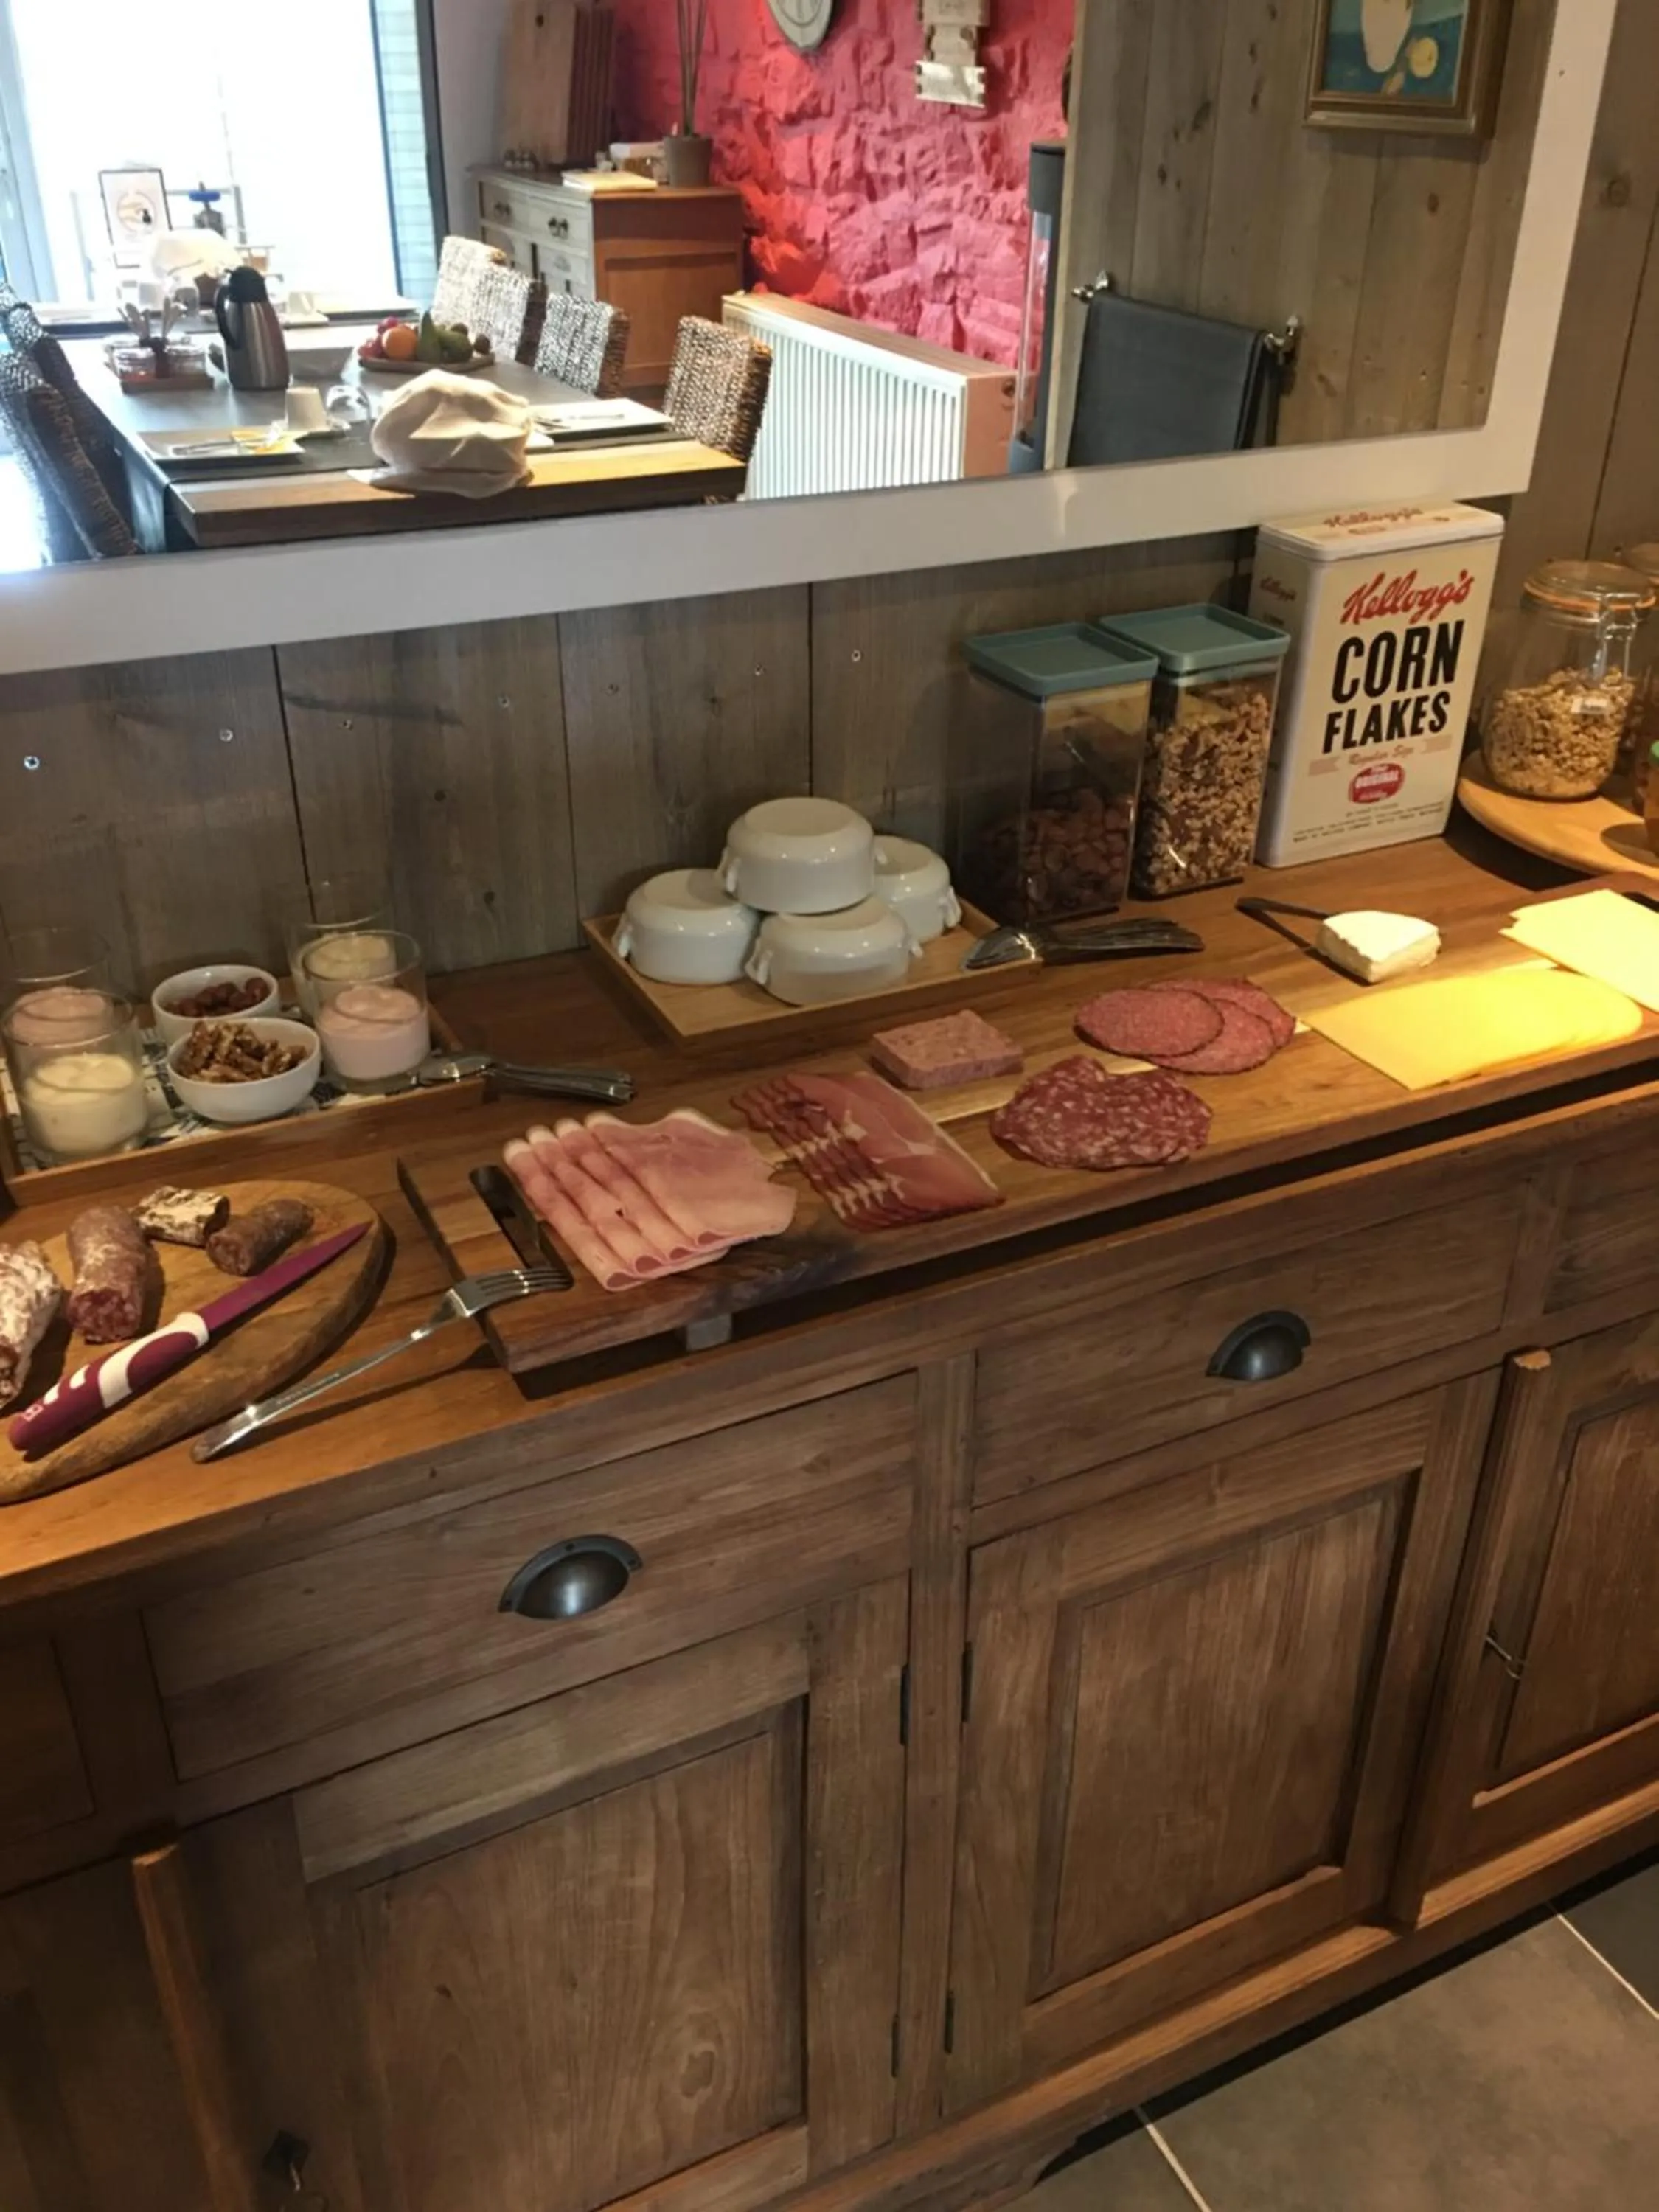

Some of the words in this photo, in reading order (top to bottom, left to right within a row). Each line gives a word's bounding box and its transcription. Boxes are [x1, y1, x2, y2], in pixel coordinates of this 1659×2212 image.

[1340, 569, 1475, 625] Kellogg's
[1332, 619, 1465, 704] CORN
[1322, 691, 1450, 754] FLAKES
